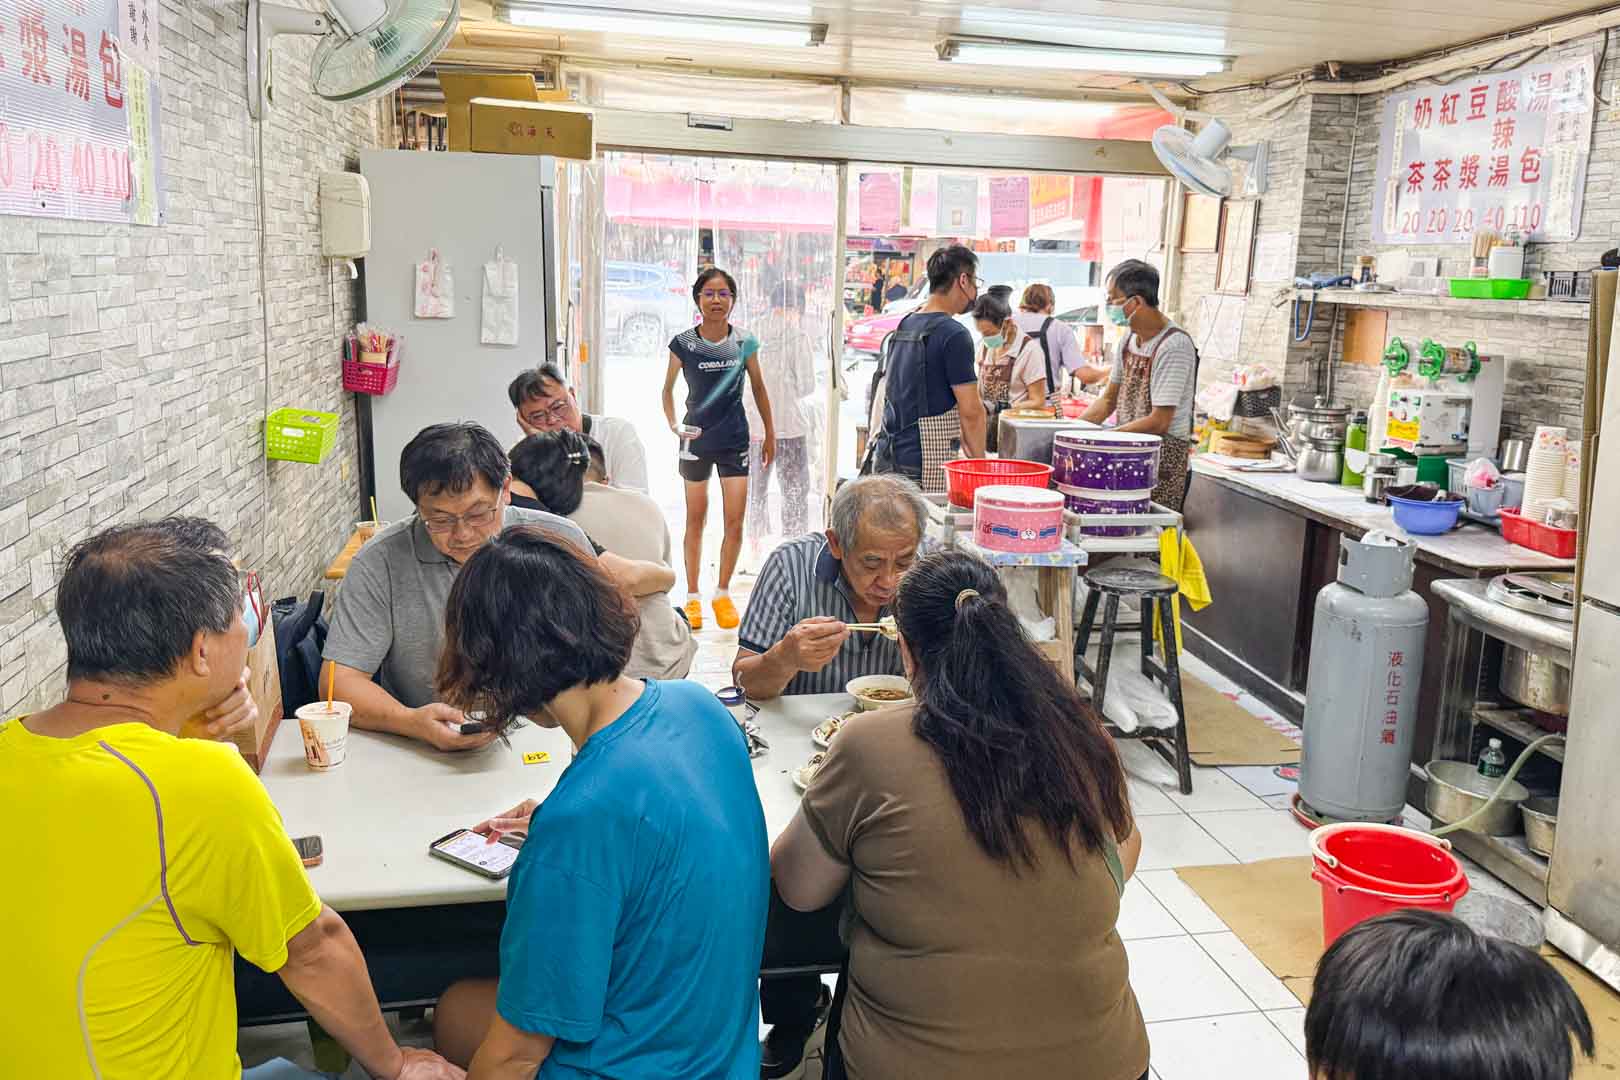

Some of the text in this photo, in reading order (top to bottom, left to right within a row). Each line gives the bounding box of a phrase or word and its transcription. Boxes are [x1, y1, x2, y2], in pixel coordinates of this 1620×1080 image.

[1402, 210, 1421, 233] 20
[1426, 208, 1447, 233] 20
[1452, 208, 1473, 233] 20
